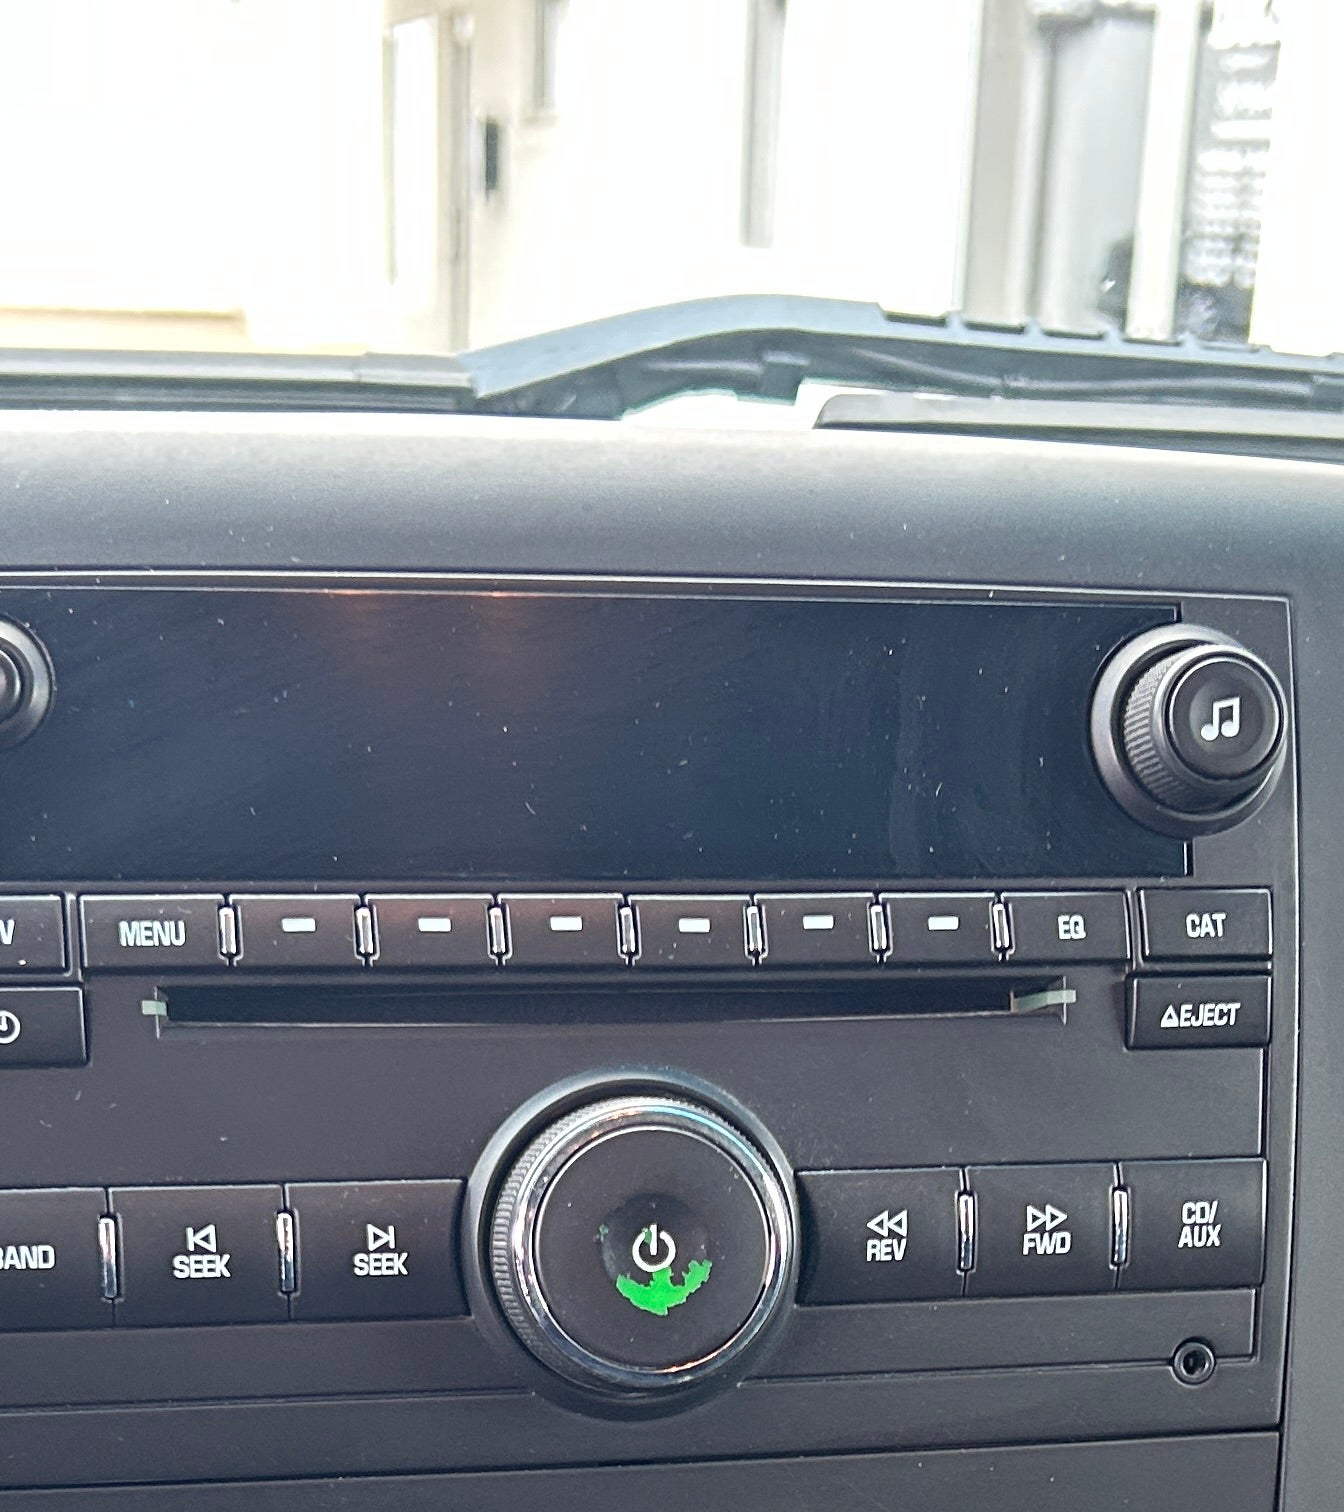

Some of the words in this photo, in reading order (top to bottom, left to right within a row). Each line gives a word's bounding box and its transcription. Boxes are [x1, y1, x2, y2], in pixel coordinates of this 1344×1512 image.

[118, 919, 186, 947] MENU
[1056, 914, 1087, 940] EQ
[1185, 913, 1227, 938] CAT
[1179, 1001, 1242, 1028] EJECT
[1022, 1230, 1072, 1256] FWD
[1177, 1224, 1222, 1248] AUX
[353, 1250, 408, 1276] SEEK
[866, 1238, 907, 1262] REV
[172, 1253, 231, 1279] SEEK
